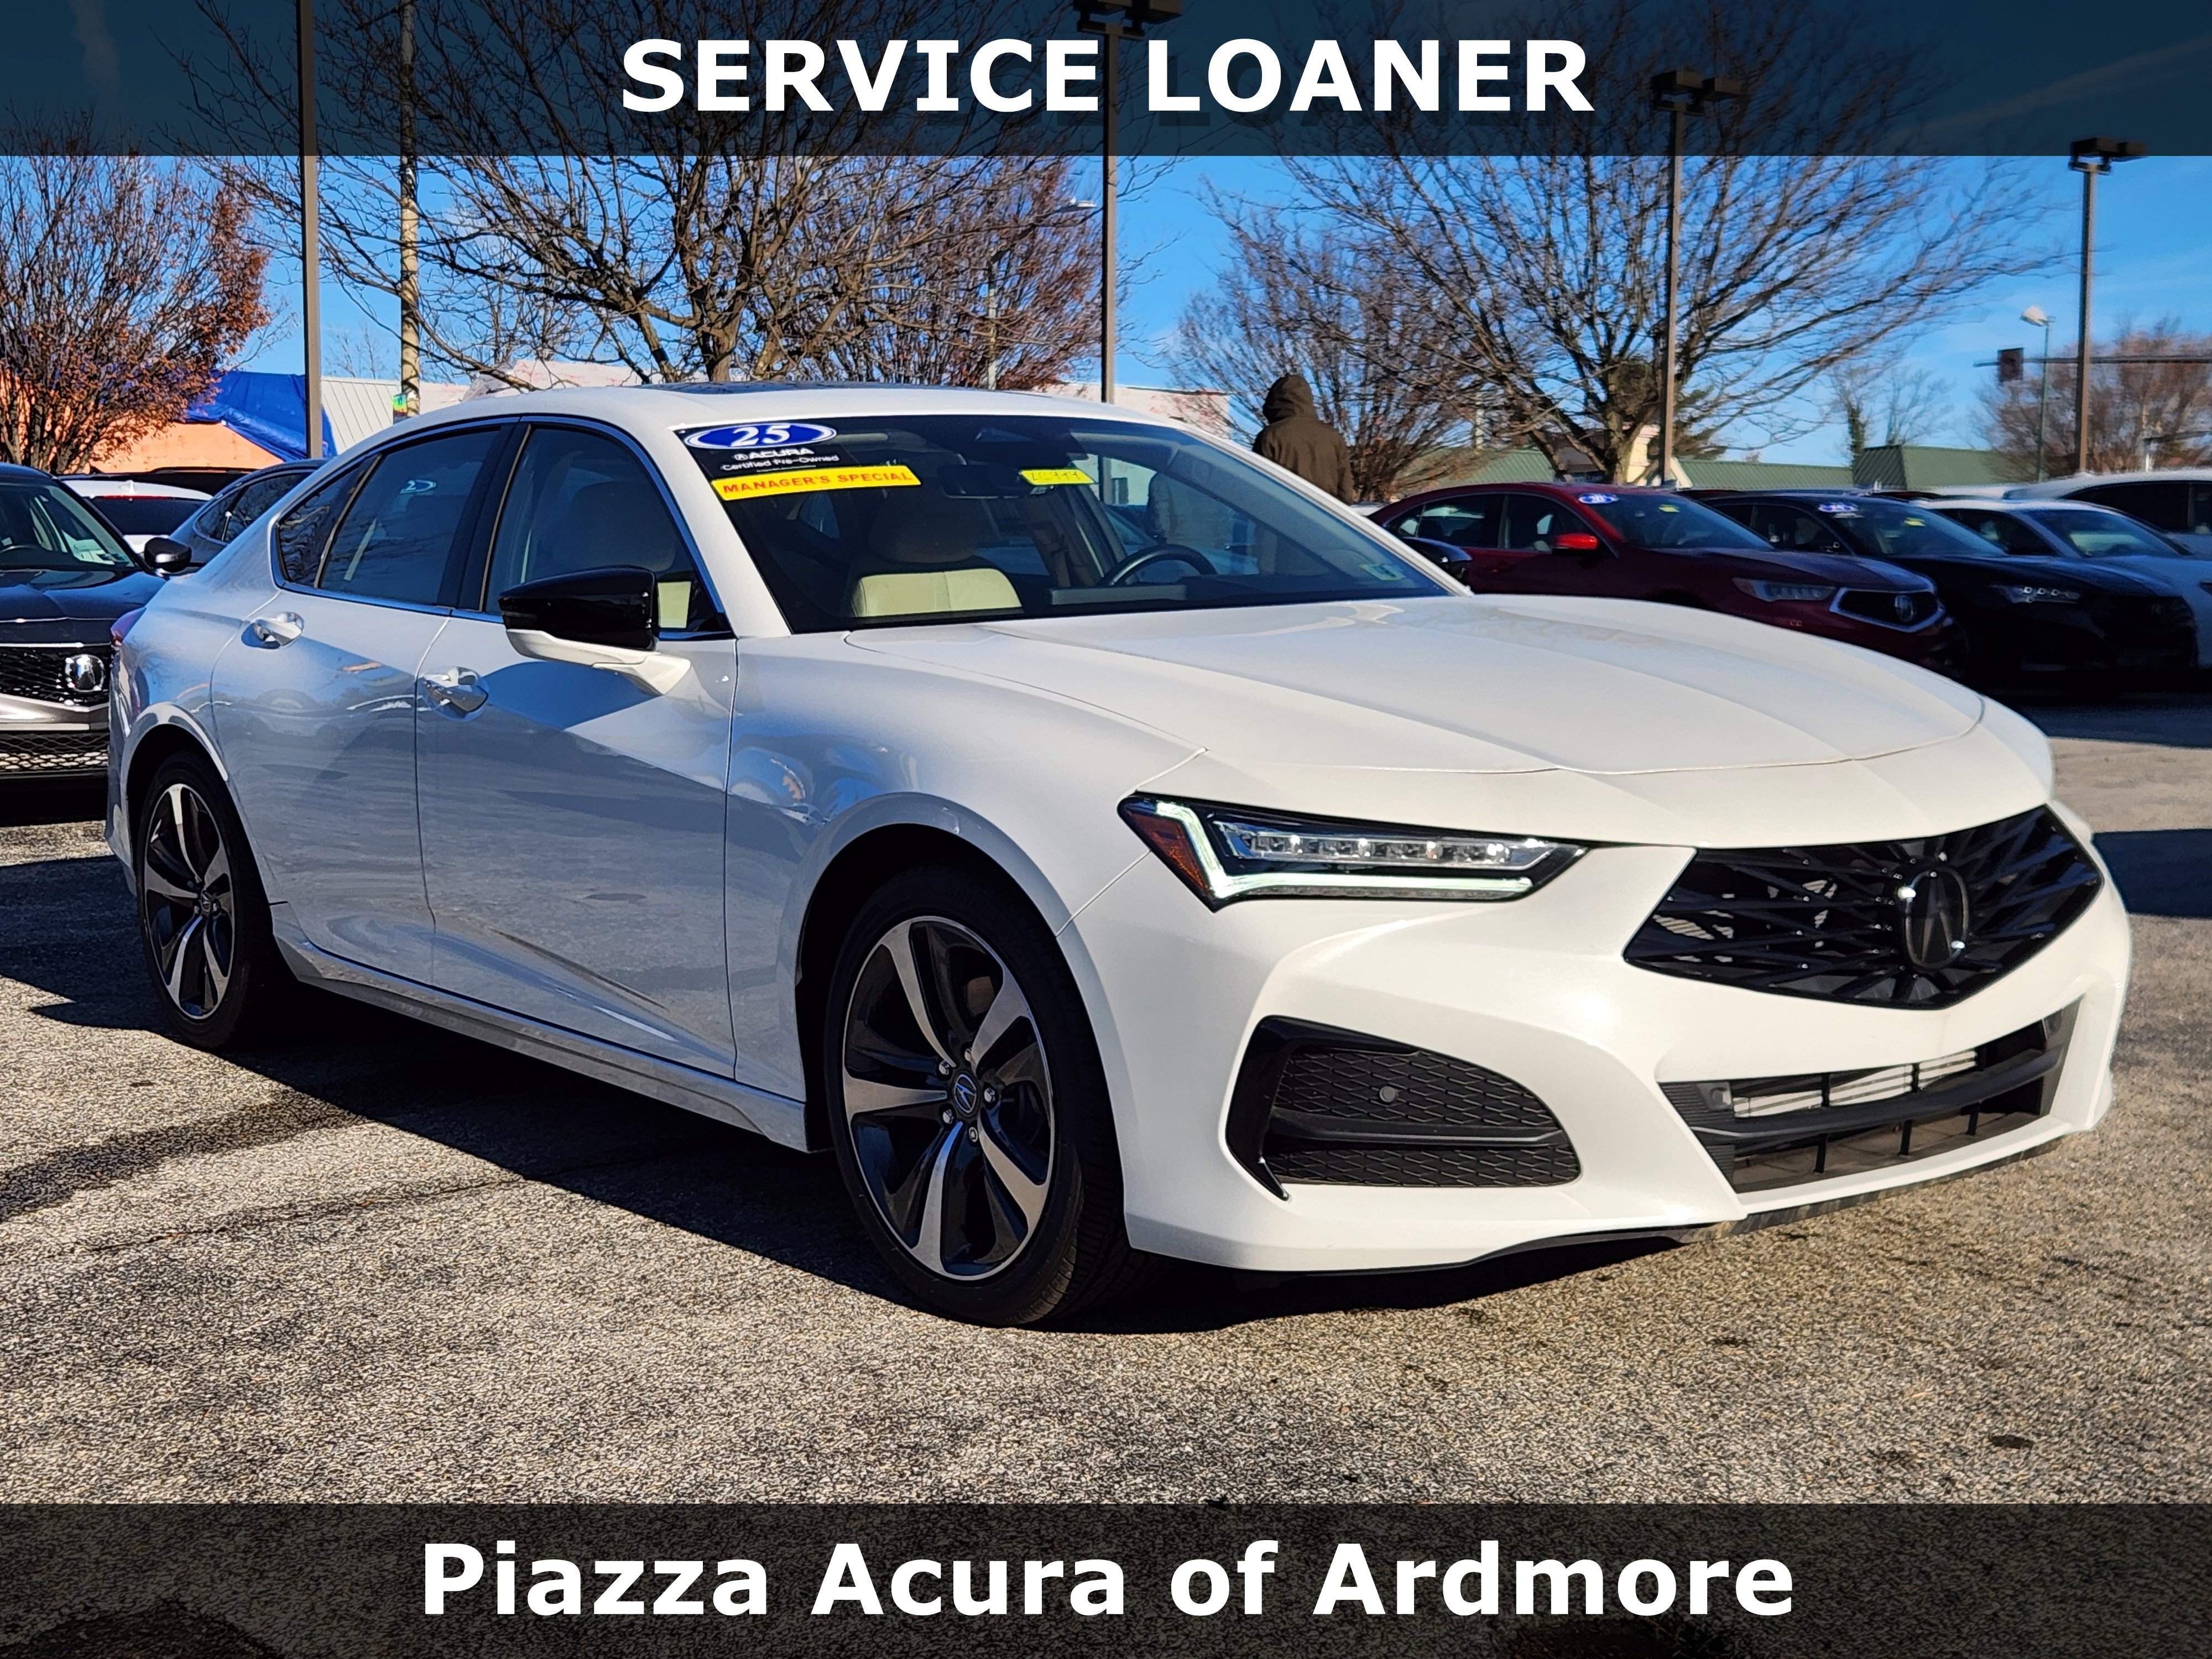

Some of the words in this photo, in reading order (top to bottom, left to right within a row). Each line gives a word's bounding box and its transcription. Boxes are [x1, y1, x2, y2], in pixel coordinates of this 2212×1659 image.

[731, 424, 791, 447] 25
[749, 447, 815, 460] ACURA
[722, 460, 772, 471] Certified
[773, 455, 840, 466] Pre-Owned
[723, 475, 830, 493] MANAGER'S
[837, 472, 914, 483] SPECIAL
